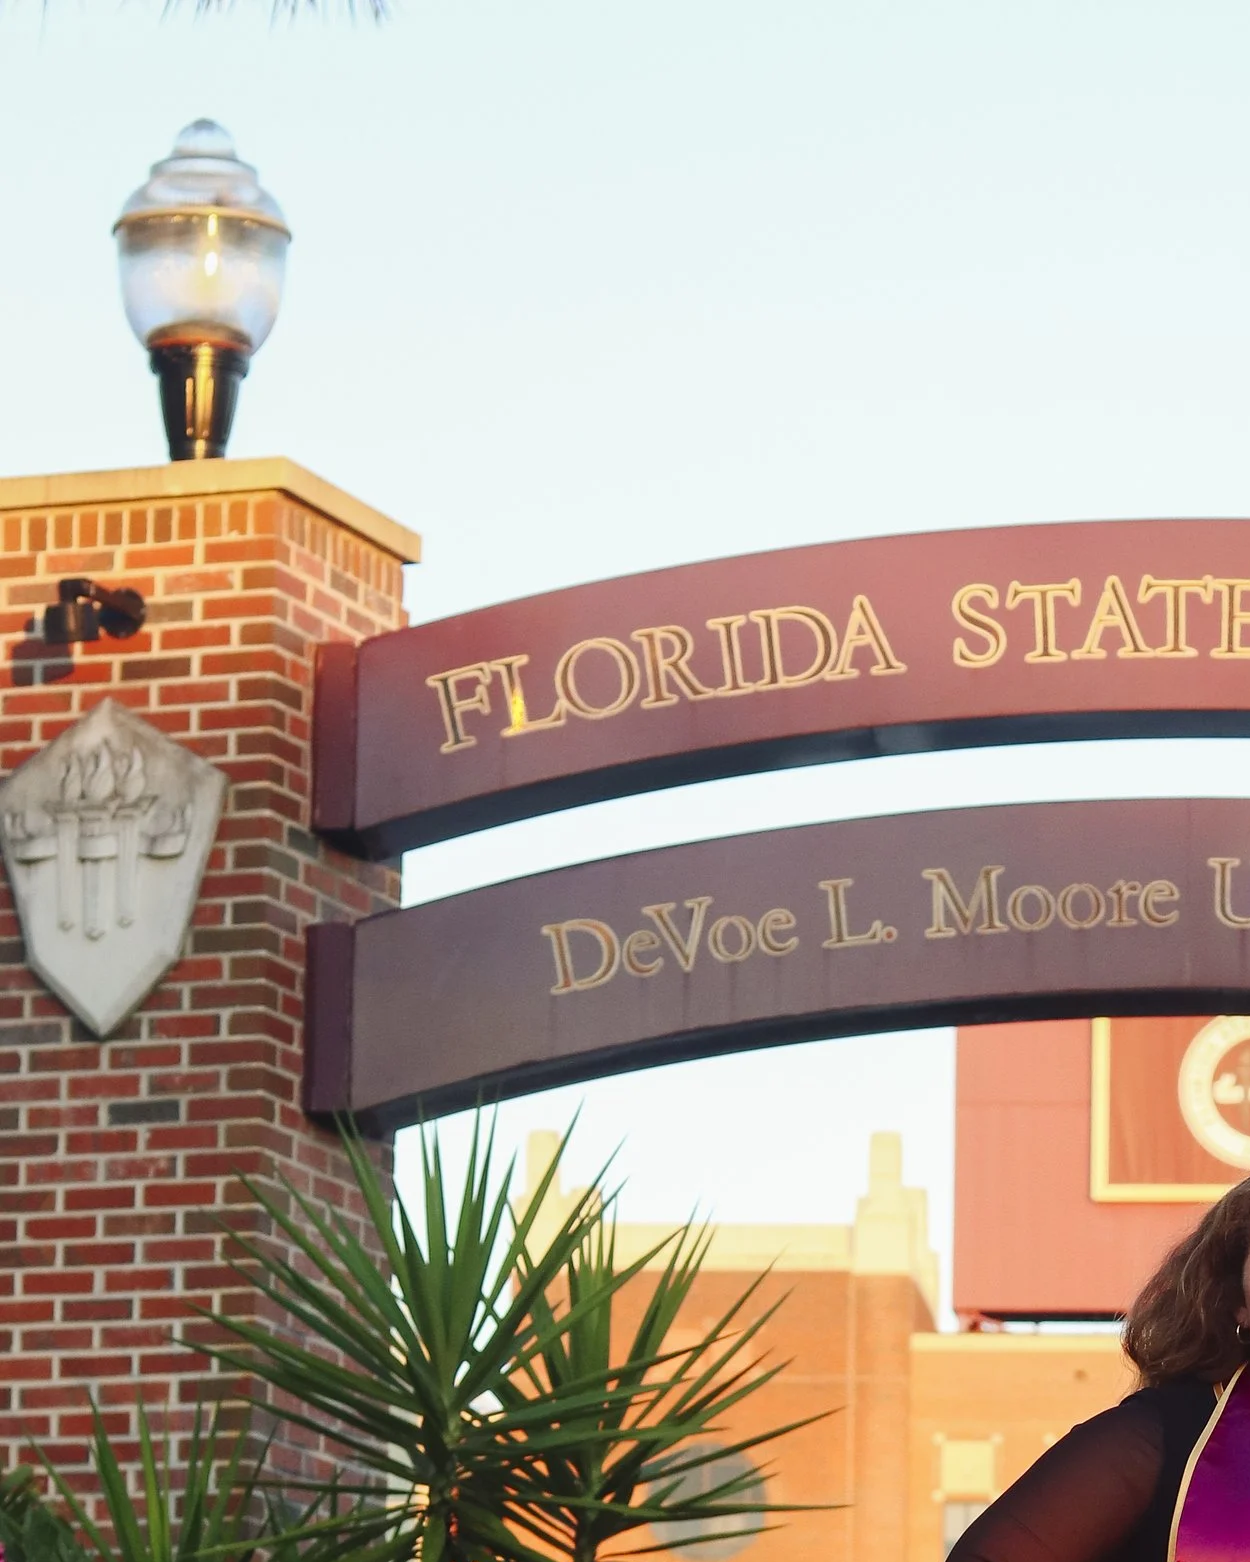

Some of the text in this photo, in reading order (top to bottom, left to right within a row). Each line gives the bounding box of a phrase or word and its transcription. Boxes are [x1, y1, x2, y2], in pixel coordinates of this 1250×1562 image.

[426, 595, 907, 754] FLORIDA
[542, 896, 799, 995] DeVoe
[819, 877, 898, 949] L.
[923, 865, 1180, 938] Moore
